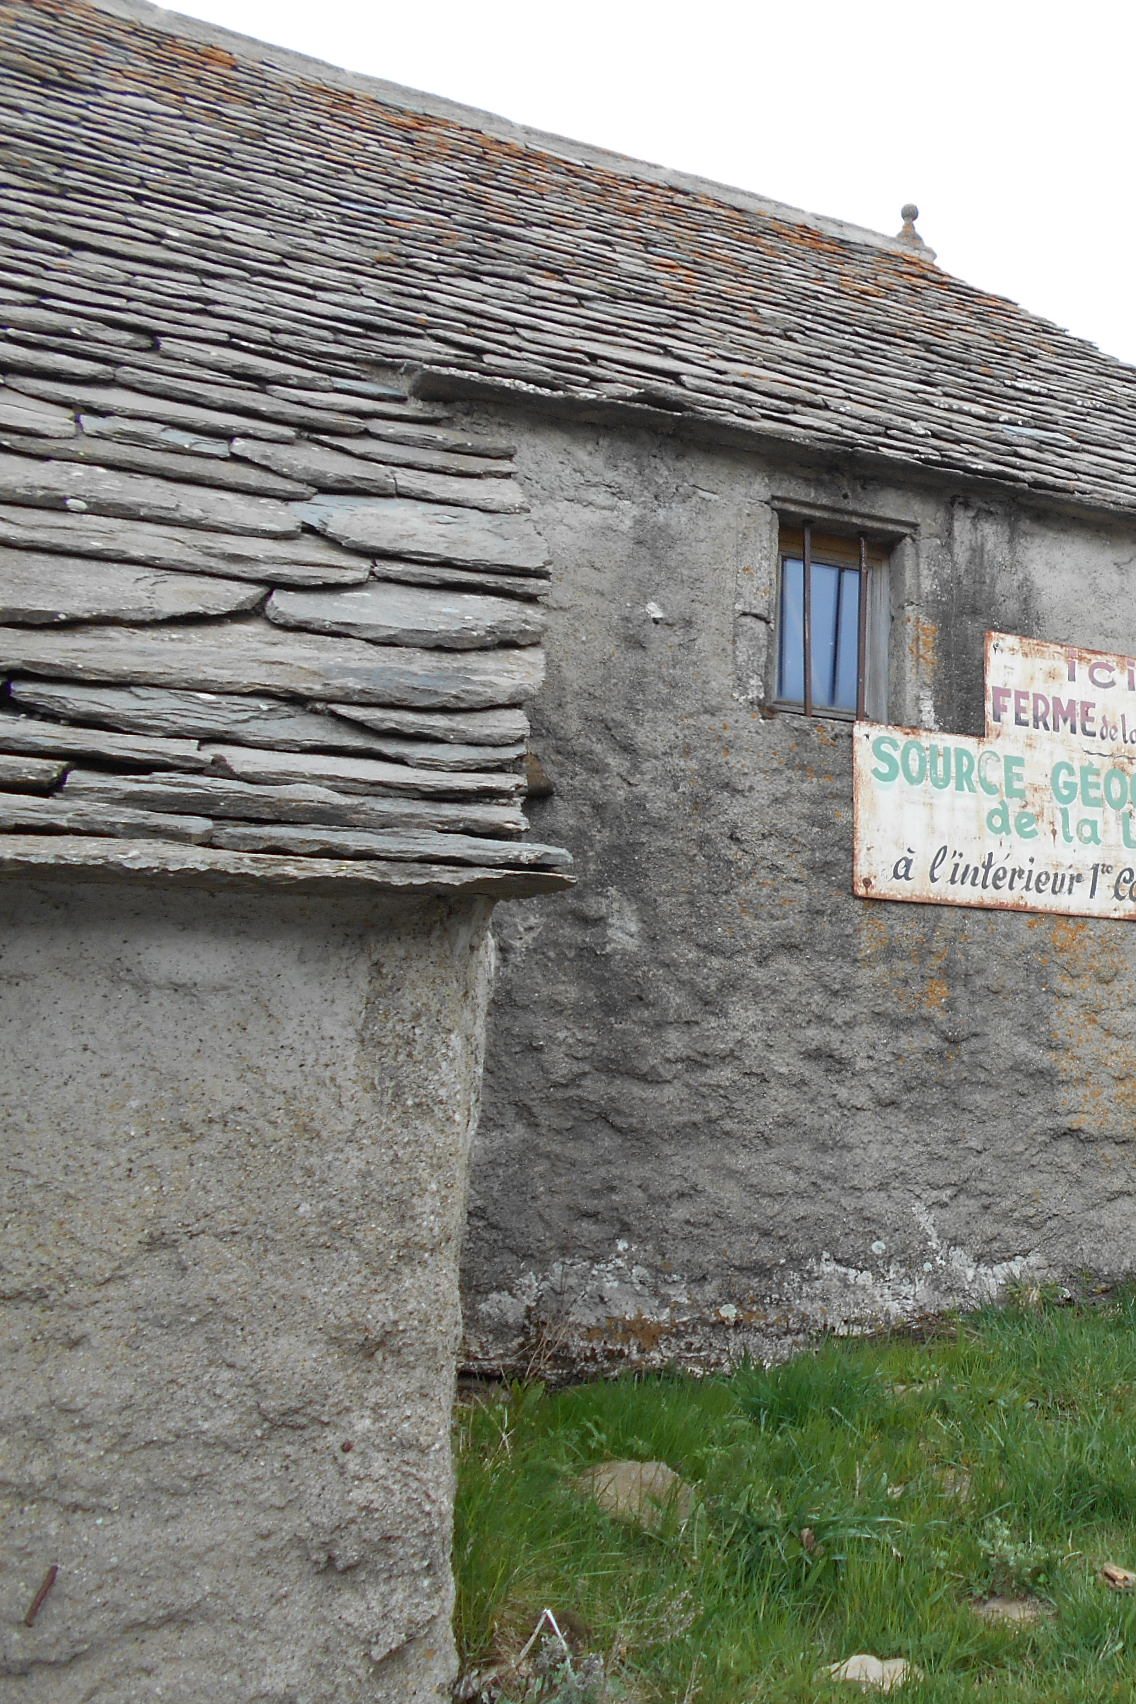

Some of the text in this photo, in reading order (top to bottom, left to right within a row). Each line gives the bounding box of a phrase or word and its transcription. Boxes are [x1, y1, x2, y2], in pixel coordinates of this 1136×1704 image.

[991, 686, 1097, 738] FERME
[1099, 715, 1118, 742] de
[871, 735, 1027, 799] SOURCE
[986, 799, 1039, 839] de
[1060, 807, 1102, 846] la
[890, 847, 916, 882] à
[929, 845, 1084, 897] l'intérieur
